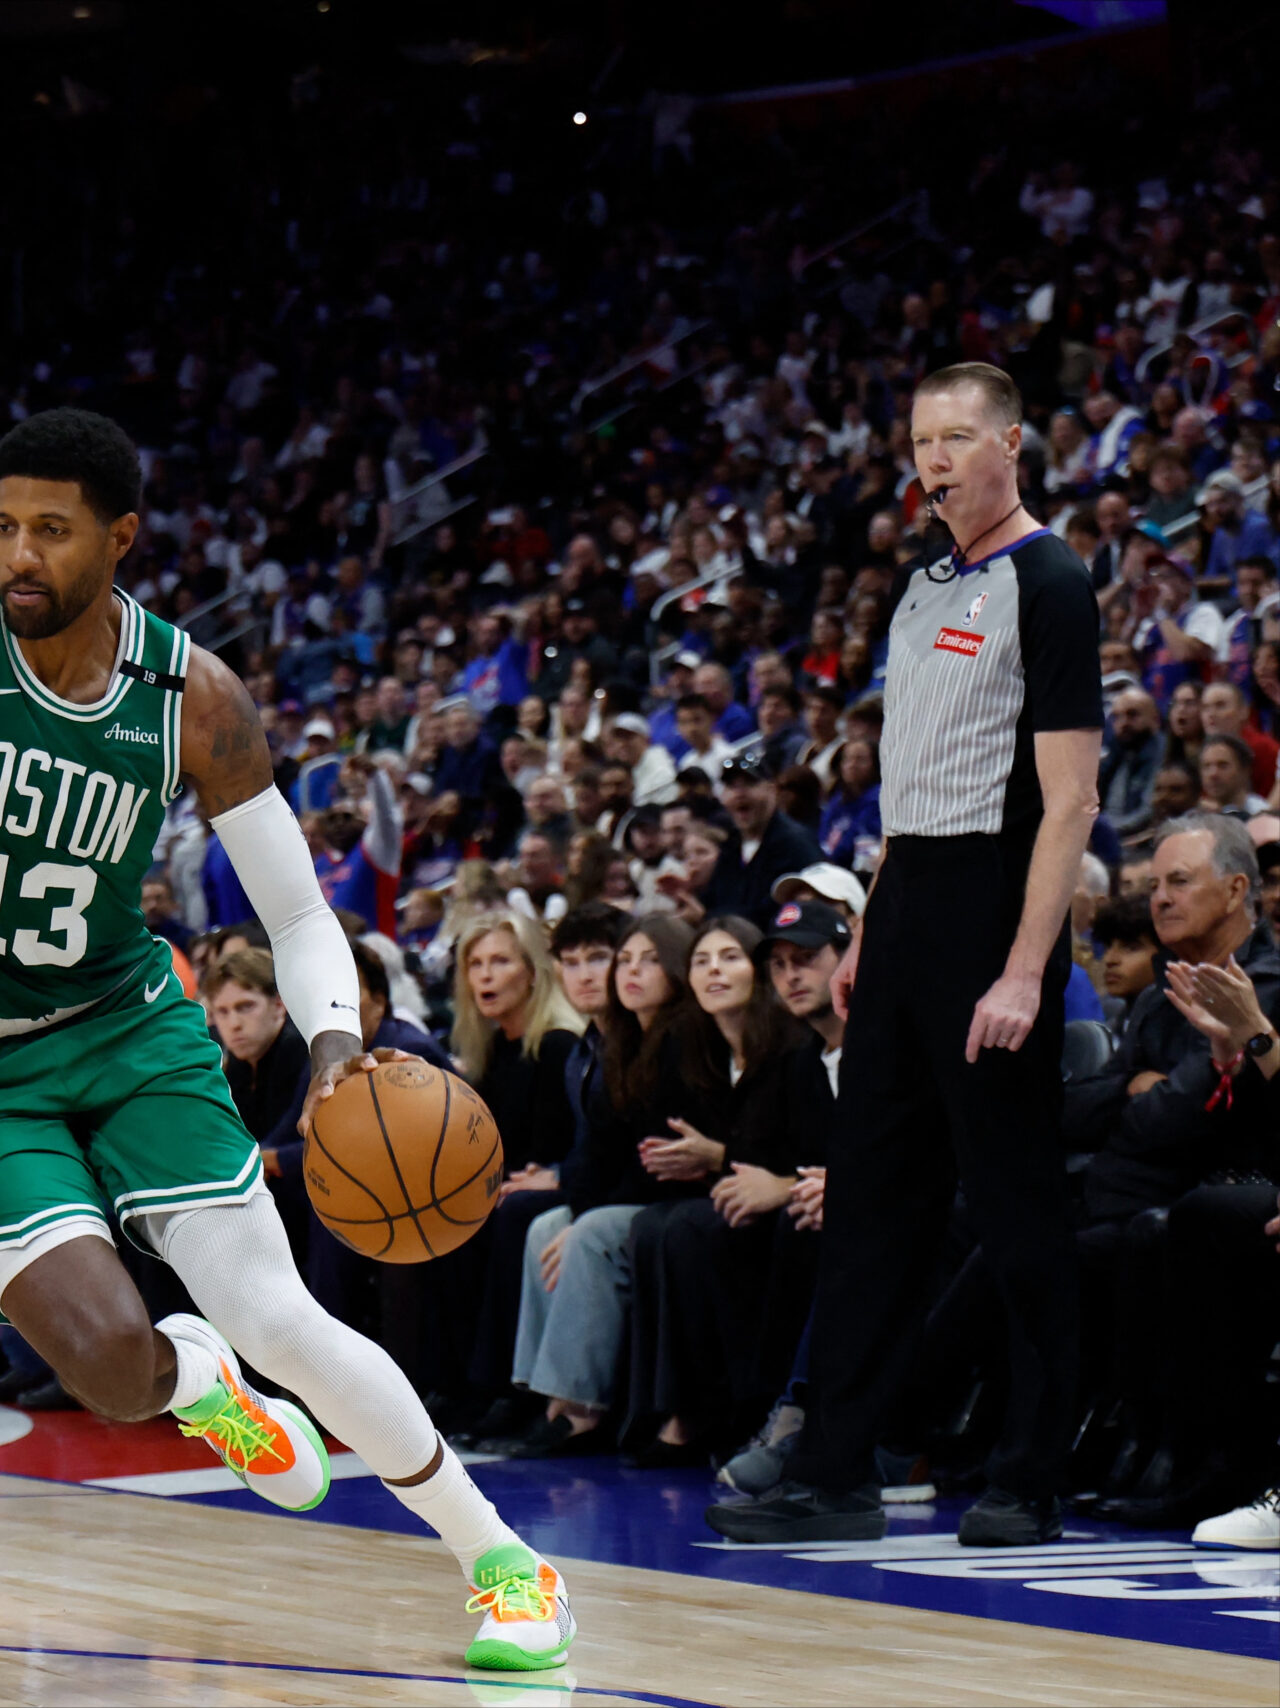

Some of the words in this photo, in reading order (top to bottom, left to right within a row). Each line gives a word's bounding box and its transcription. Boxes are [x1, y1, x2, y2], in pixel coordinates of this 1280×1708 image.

[937, 632, 981, 652] Emirates
[143, 670, 157, 685] 19
[104, 722, 159, 745] Amica
